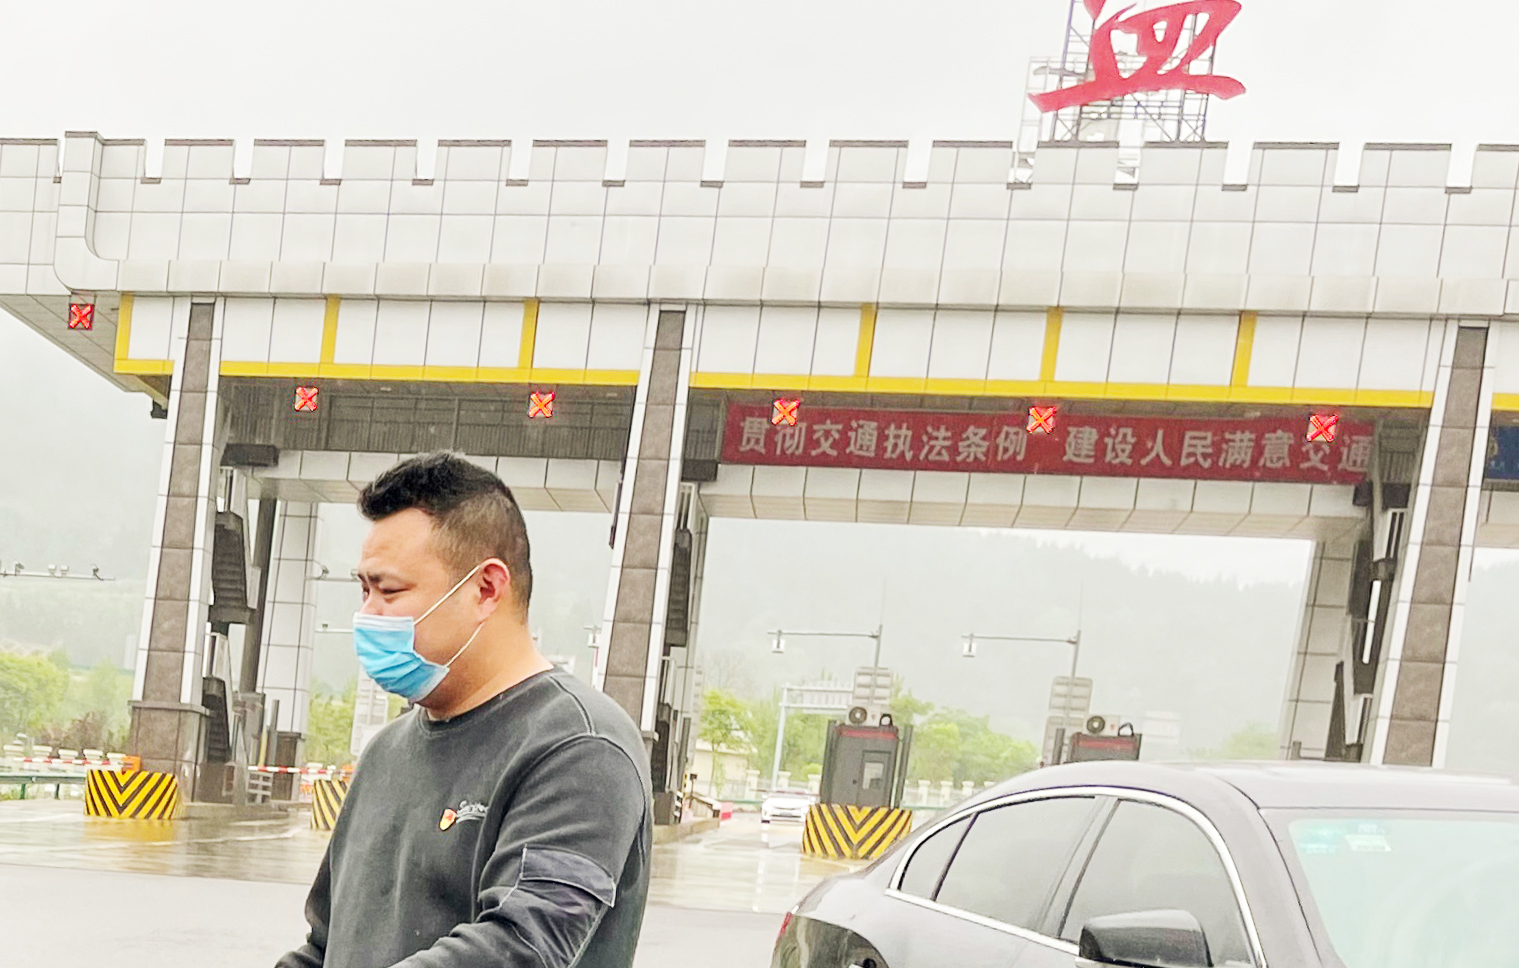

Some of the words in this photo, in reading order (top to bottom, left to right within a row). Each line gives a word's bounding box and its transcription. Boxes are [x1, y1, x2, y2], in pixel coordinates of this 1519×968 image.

[738, 415, 1029, 463] 贯彻交通执法条例
[1063, 424, 1374, 473] 建设人民满意交通
